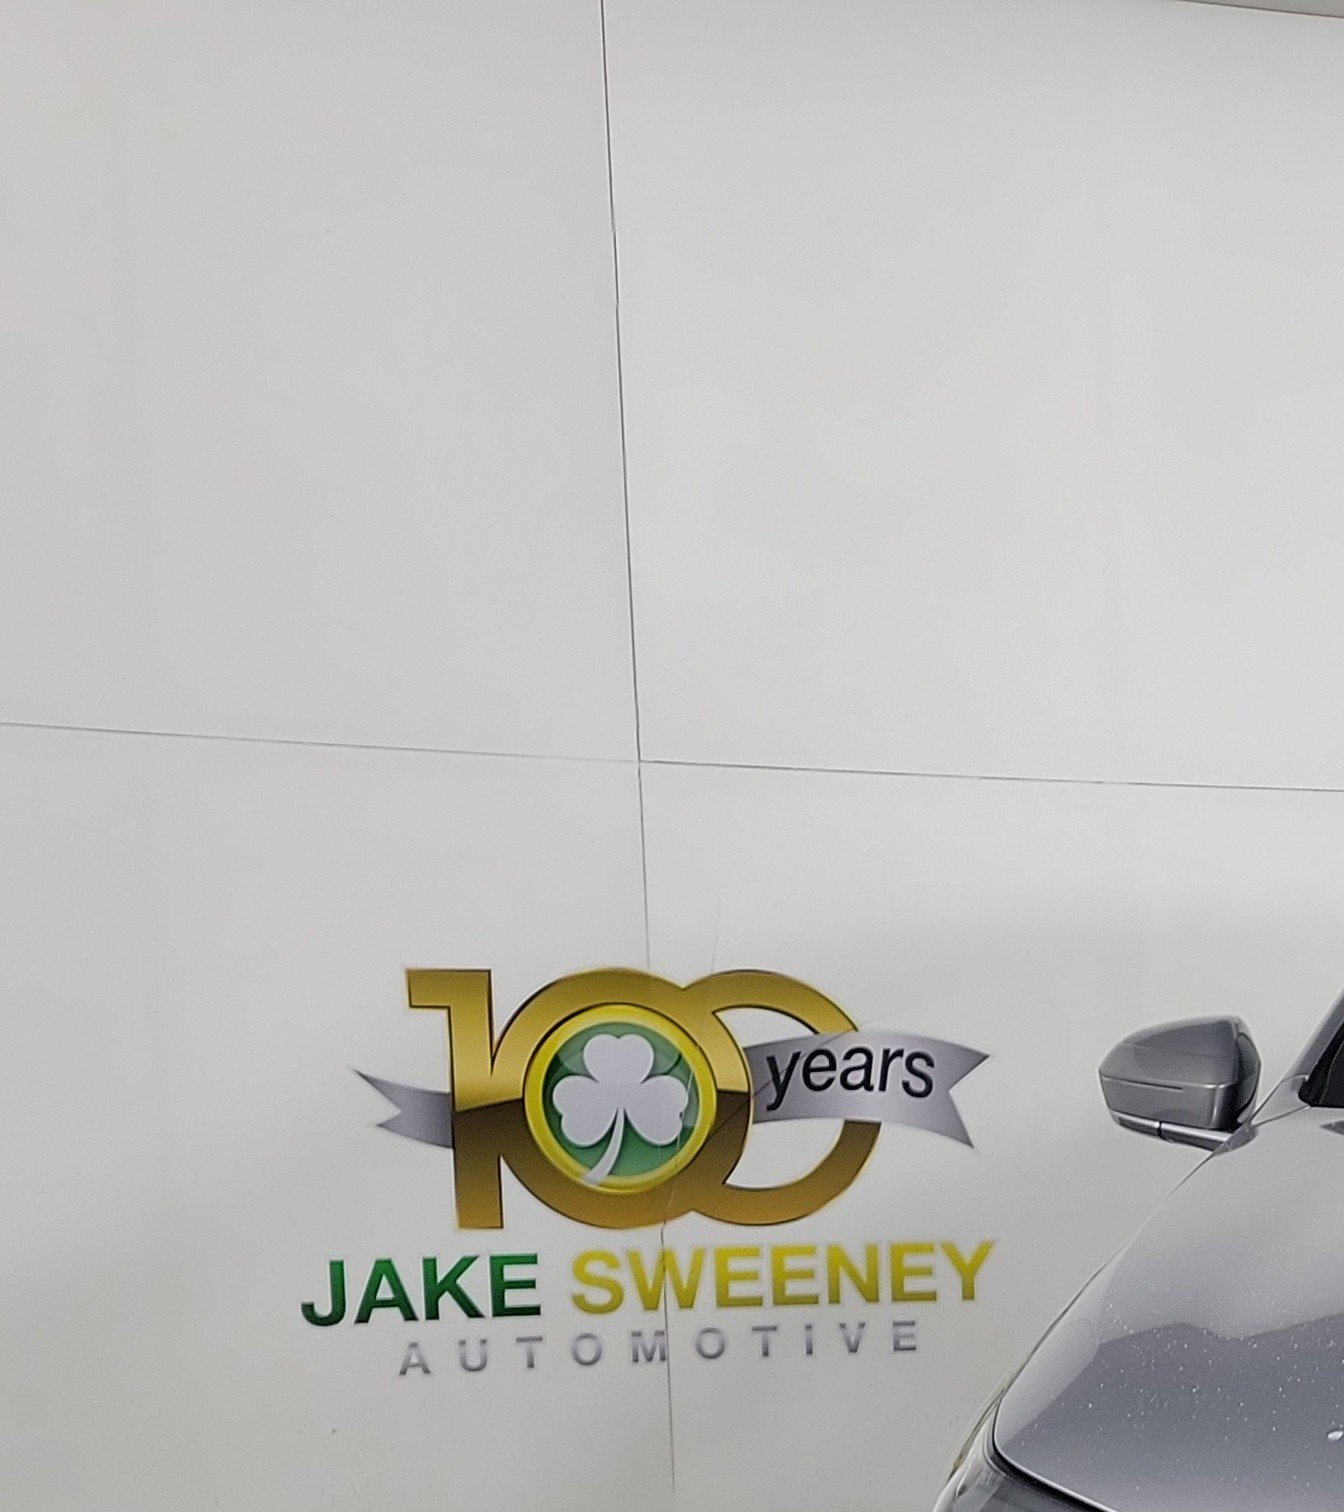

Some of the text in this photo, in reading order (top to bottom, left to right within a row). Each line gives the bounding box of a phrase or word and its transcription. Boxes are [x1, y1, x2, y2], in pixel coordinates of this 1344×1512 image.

[404, 966, 937, 1231] 100 years
[301, 1240, 995, 1328] JAKE SWEENEY
[397, 1320, 919, 1378] AUTOMOTIVE
